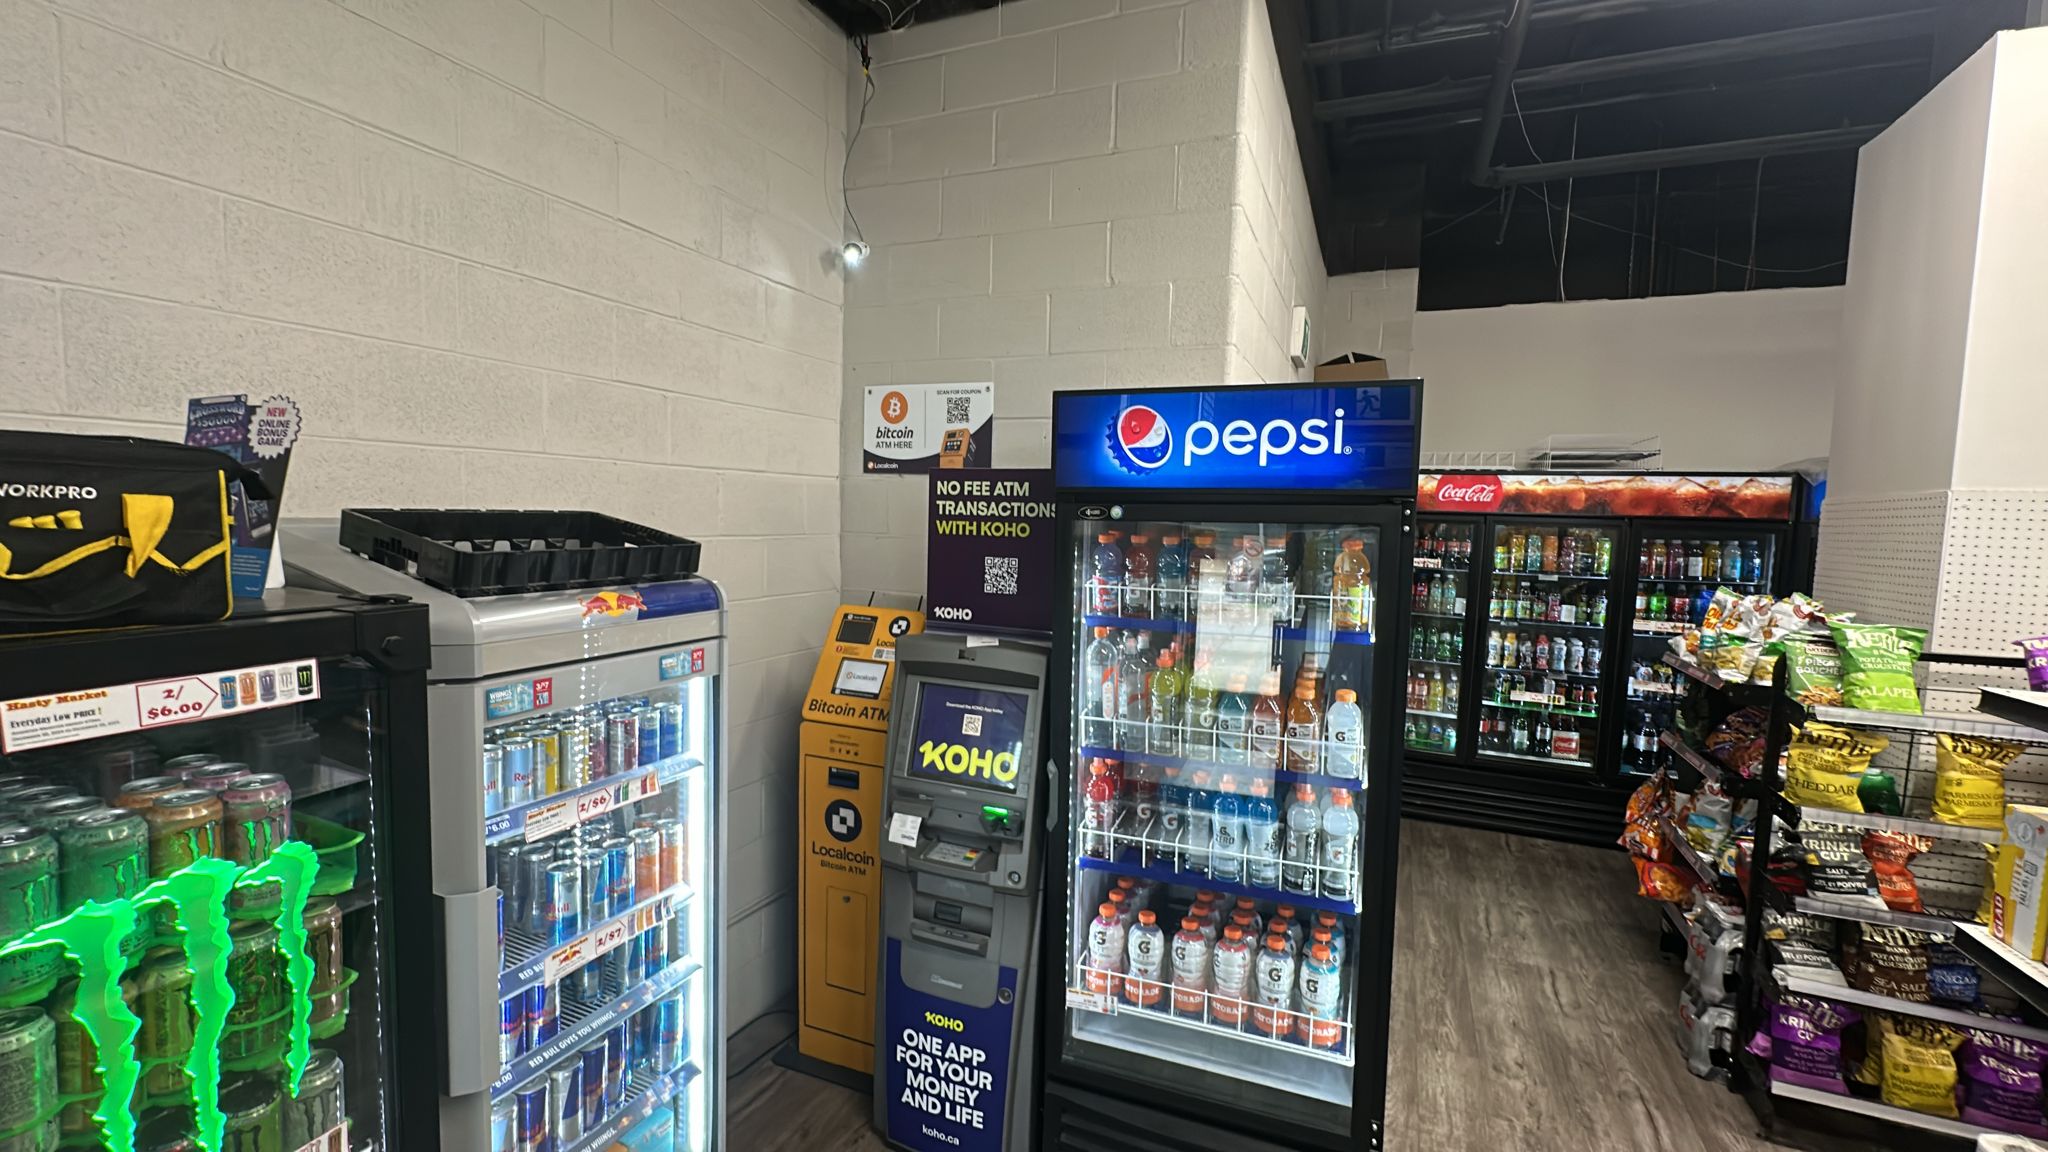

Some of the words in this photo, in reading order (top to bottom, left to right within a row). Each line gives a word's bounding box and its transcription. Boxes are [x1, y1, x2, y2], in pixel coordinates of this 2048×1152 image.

[266, 407, 288, 417] NEW
[258, 419, 291, 429] ONLINE
[256, 428, 288, 438] BONUS
[876, 427, 914, 439] bitcoin
[257, 438, 284, 447] GAME
[875, 441, 892, 449] ATM
[893, 441, 913, 449] HERE
[937, 480, 960, 495] NO
[964, 481, 991, 496] FEE
[994, 481, 1029, 497] ATM
[936, 520, 977, 536] WITH
[980, 521, 1030, 537] KOHO
[934, 606, 972, 620] KOHO
[6, 699, 51, 711] Hasty
[55, 690, 108, 704] Market
[162, 685, 184, 700] 2/
[147, 702, 203, 720] $6.00
[808, 698, 856, 718] Bitcoin
[858, 706, 890, 721] ATM
[10, 715, 50, 729] Everyday
[74, 708, 96, 719] PRICE
[919, 740, 1018, 782] KOHO
[1787, 776, 1855, 795] CHEDDAR
[812, 840, 875, 867] Localcoin
[1820, 851, 1850, 861] CUT
[820, 859, 847, 872] Bitcoin
[847, 864, 867, 876] ATM
[1994, 896, 2005, 939] GLAD
[518, 967, 534, 981] RED
[1268, 967, 1282, 982] G
[1306, 979, 1319, 993] G
[1901, 983, 1927, 992] SALT
[925, 1011, 964, 1032] KOHO
[529, 1054, 544, 1068] RED
[544, 1045, 561, 1062] BULL
[560, 1035, 579, 1049] GIVES
[578, 1027, 592, 1039] YOU
[902, 1028, 943, 1057] ONE
[944, 1042, 986, 1067] APP
[896, 1044, 933, 1074] FOR
[936, 1058, 993, 1091] YOUR
[906, 1068, 980, 1107] MONEY
[901, 1087, 941, 1115] AND
[945, 1101, 984, 1129] LIFE
[922, 1124, 960, 1146] koho.ca
